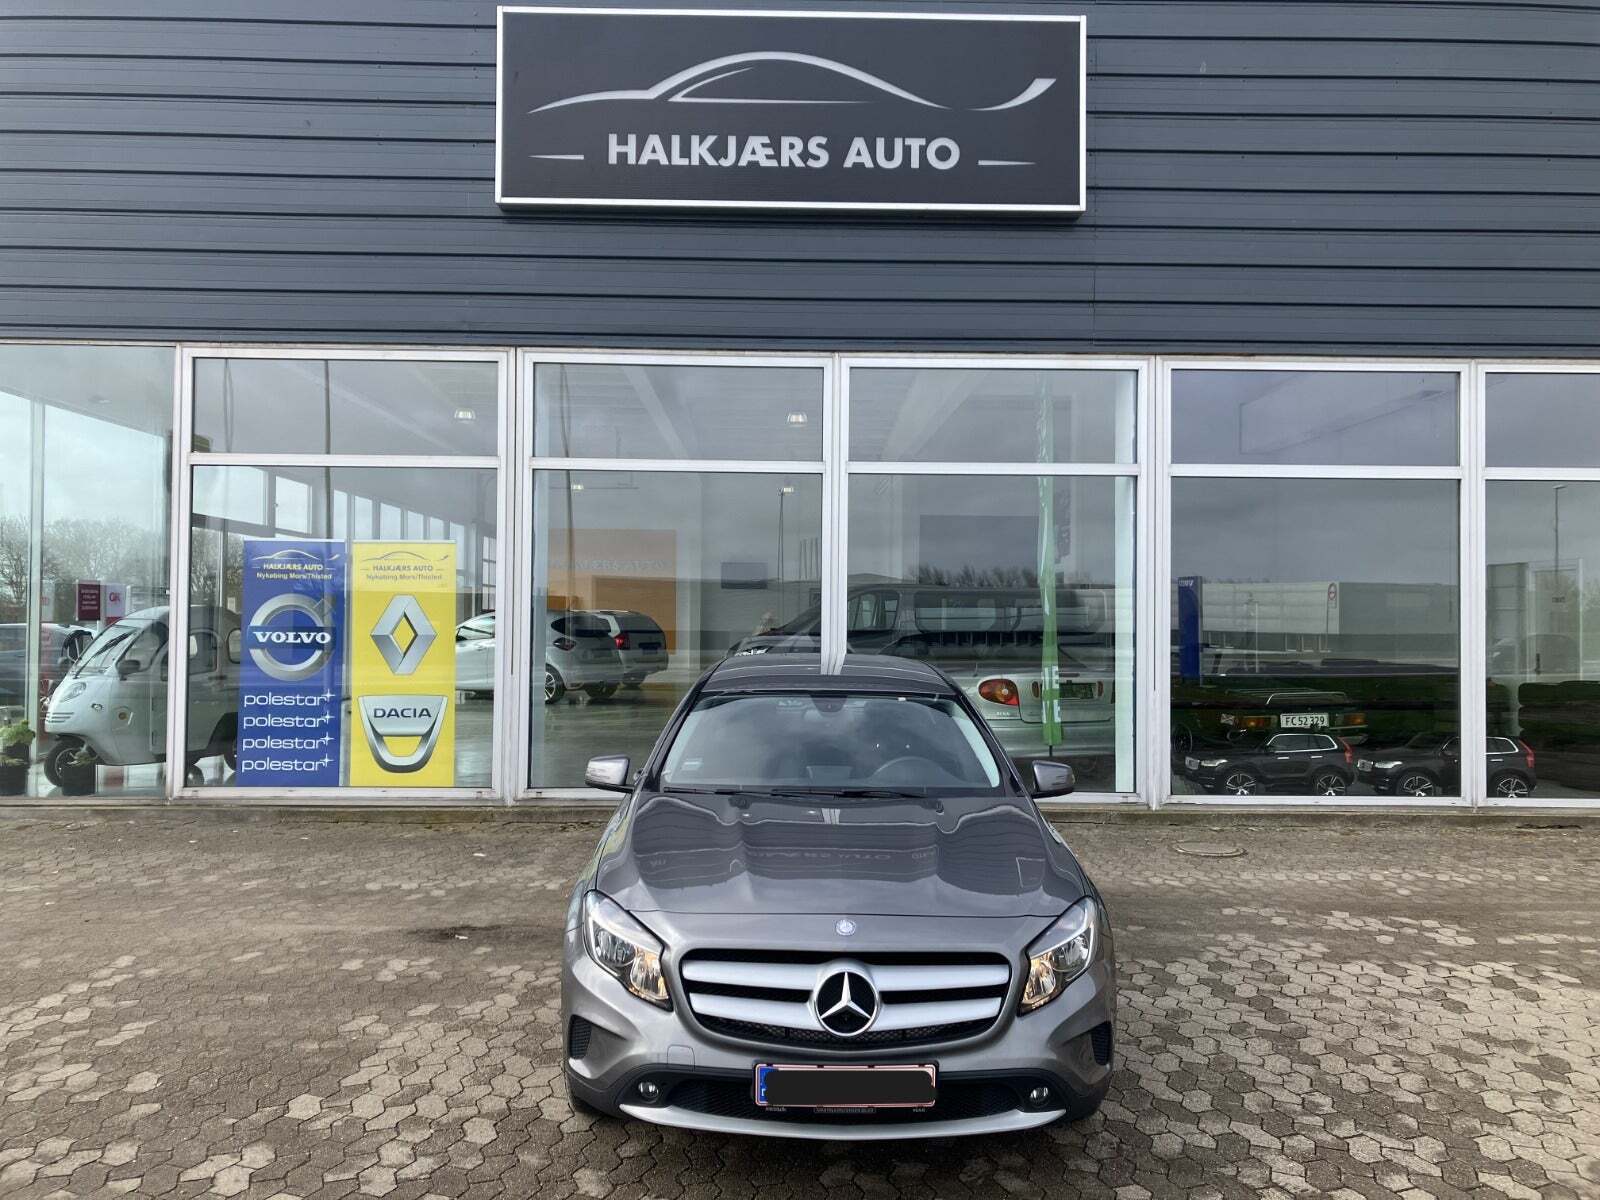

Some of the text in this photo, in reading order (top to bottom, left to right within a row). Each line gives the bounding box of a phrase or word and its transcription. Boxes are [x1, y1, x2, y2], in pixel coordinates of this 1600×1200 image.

[607, 133, 961, 171] HALKJÆRS AUTO
[303, 563, 324, 571] AUTO
[252, 631, 331, 644] VOLVO
[244, 691, 328, 707] polestar
[243, 713, 328, 729] polestar
[373, 707, 432, 719] DACIA
[1285, 716, 1297, 726] FC
[1298, 716, 1308, 726] 52
[242, 735, 327, 751] polestar
[241, 757, 326, 773] polestar
